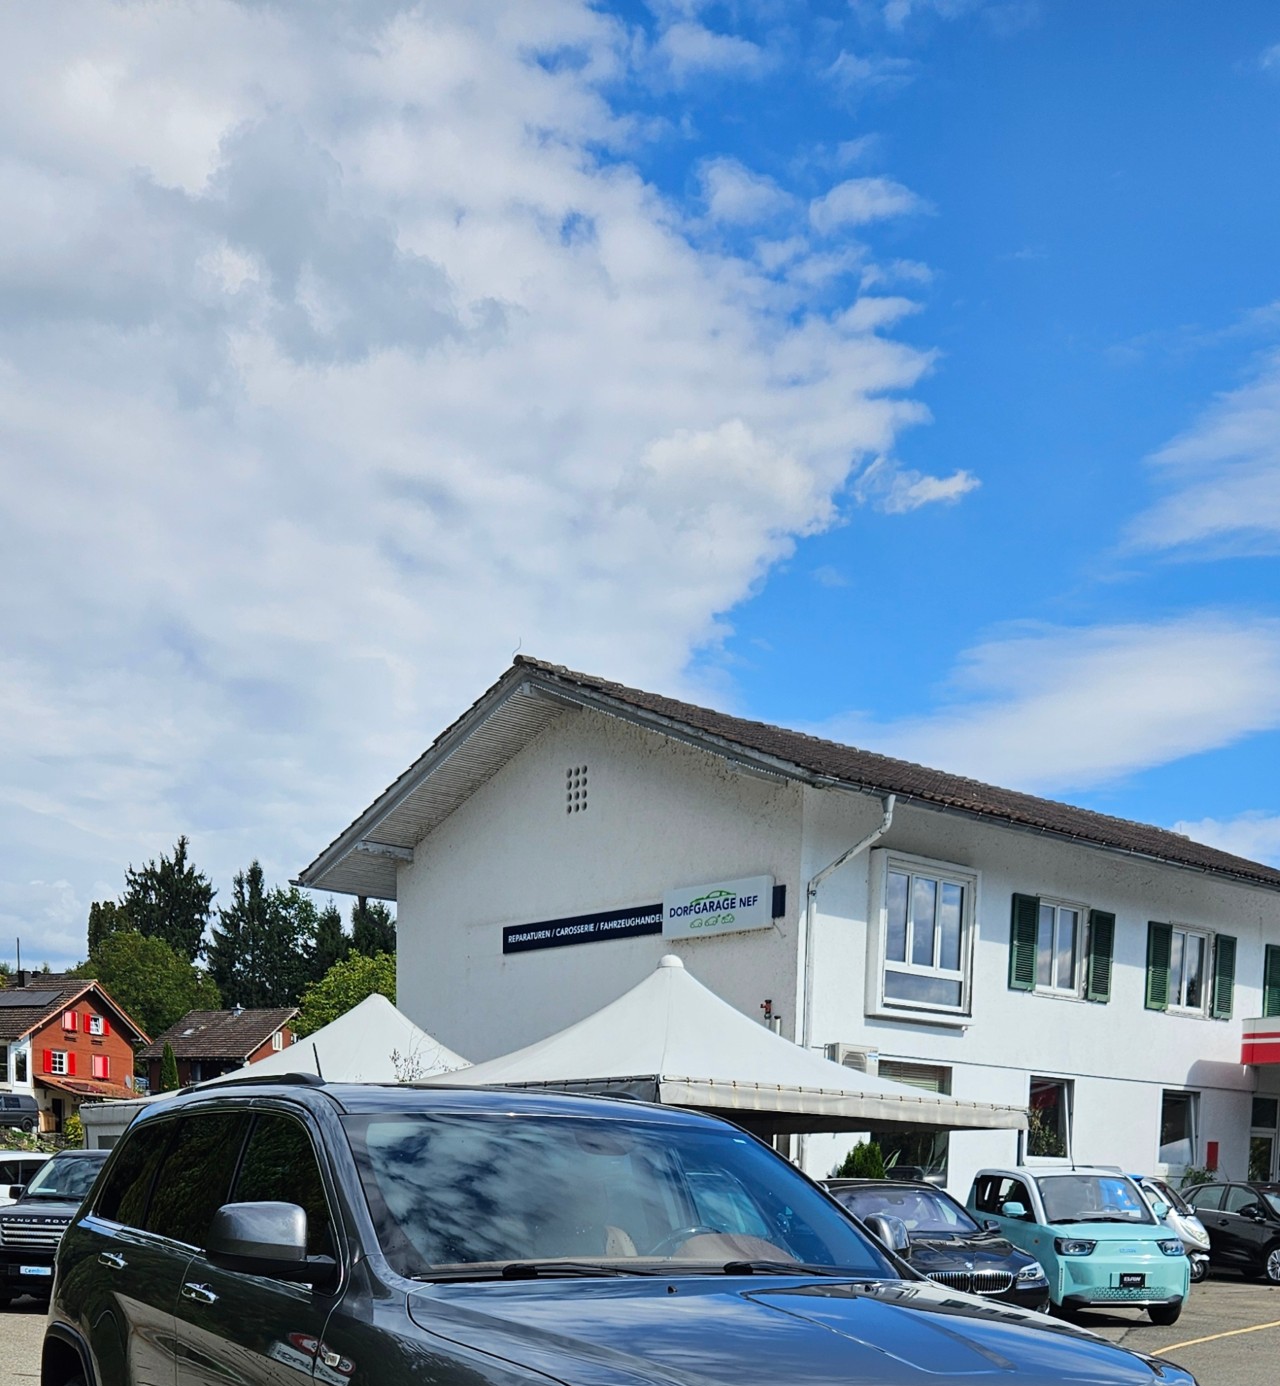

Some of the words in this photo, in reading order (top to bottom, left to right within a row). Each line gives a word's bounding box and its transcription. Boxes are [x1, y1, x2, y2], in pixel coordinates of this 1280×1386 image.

[669, 897, 737, 918] DORFGARAGE
[739, 895, 758, 908] NEF
[508, 930, 550, 943] REPARATUREN
[555, 923, 594, 937] CAROSSERIE
[600, 914, 663, 931] FAHRZEUGHANDEL
